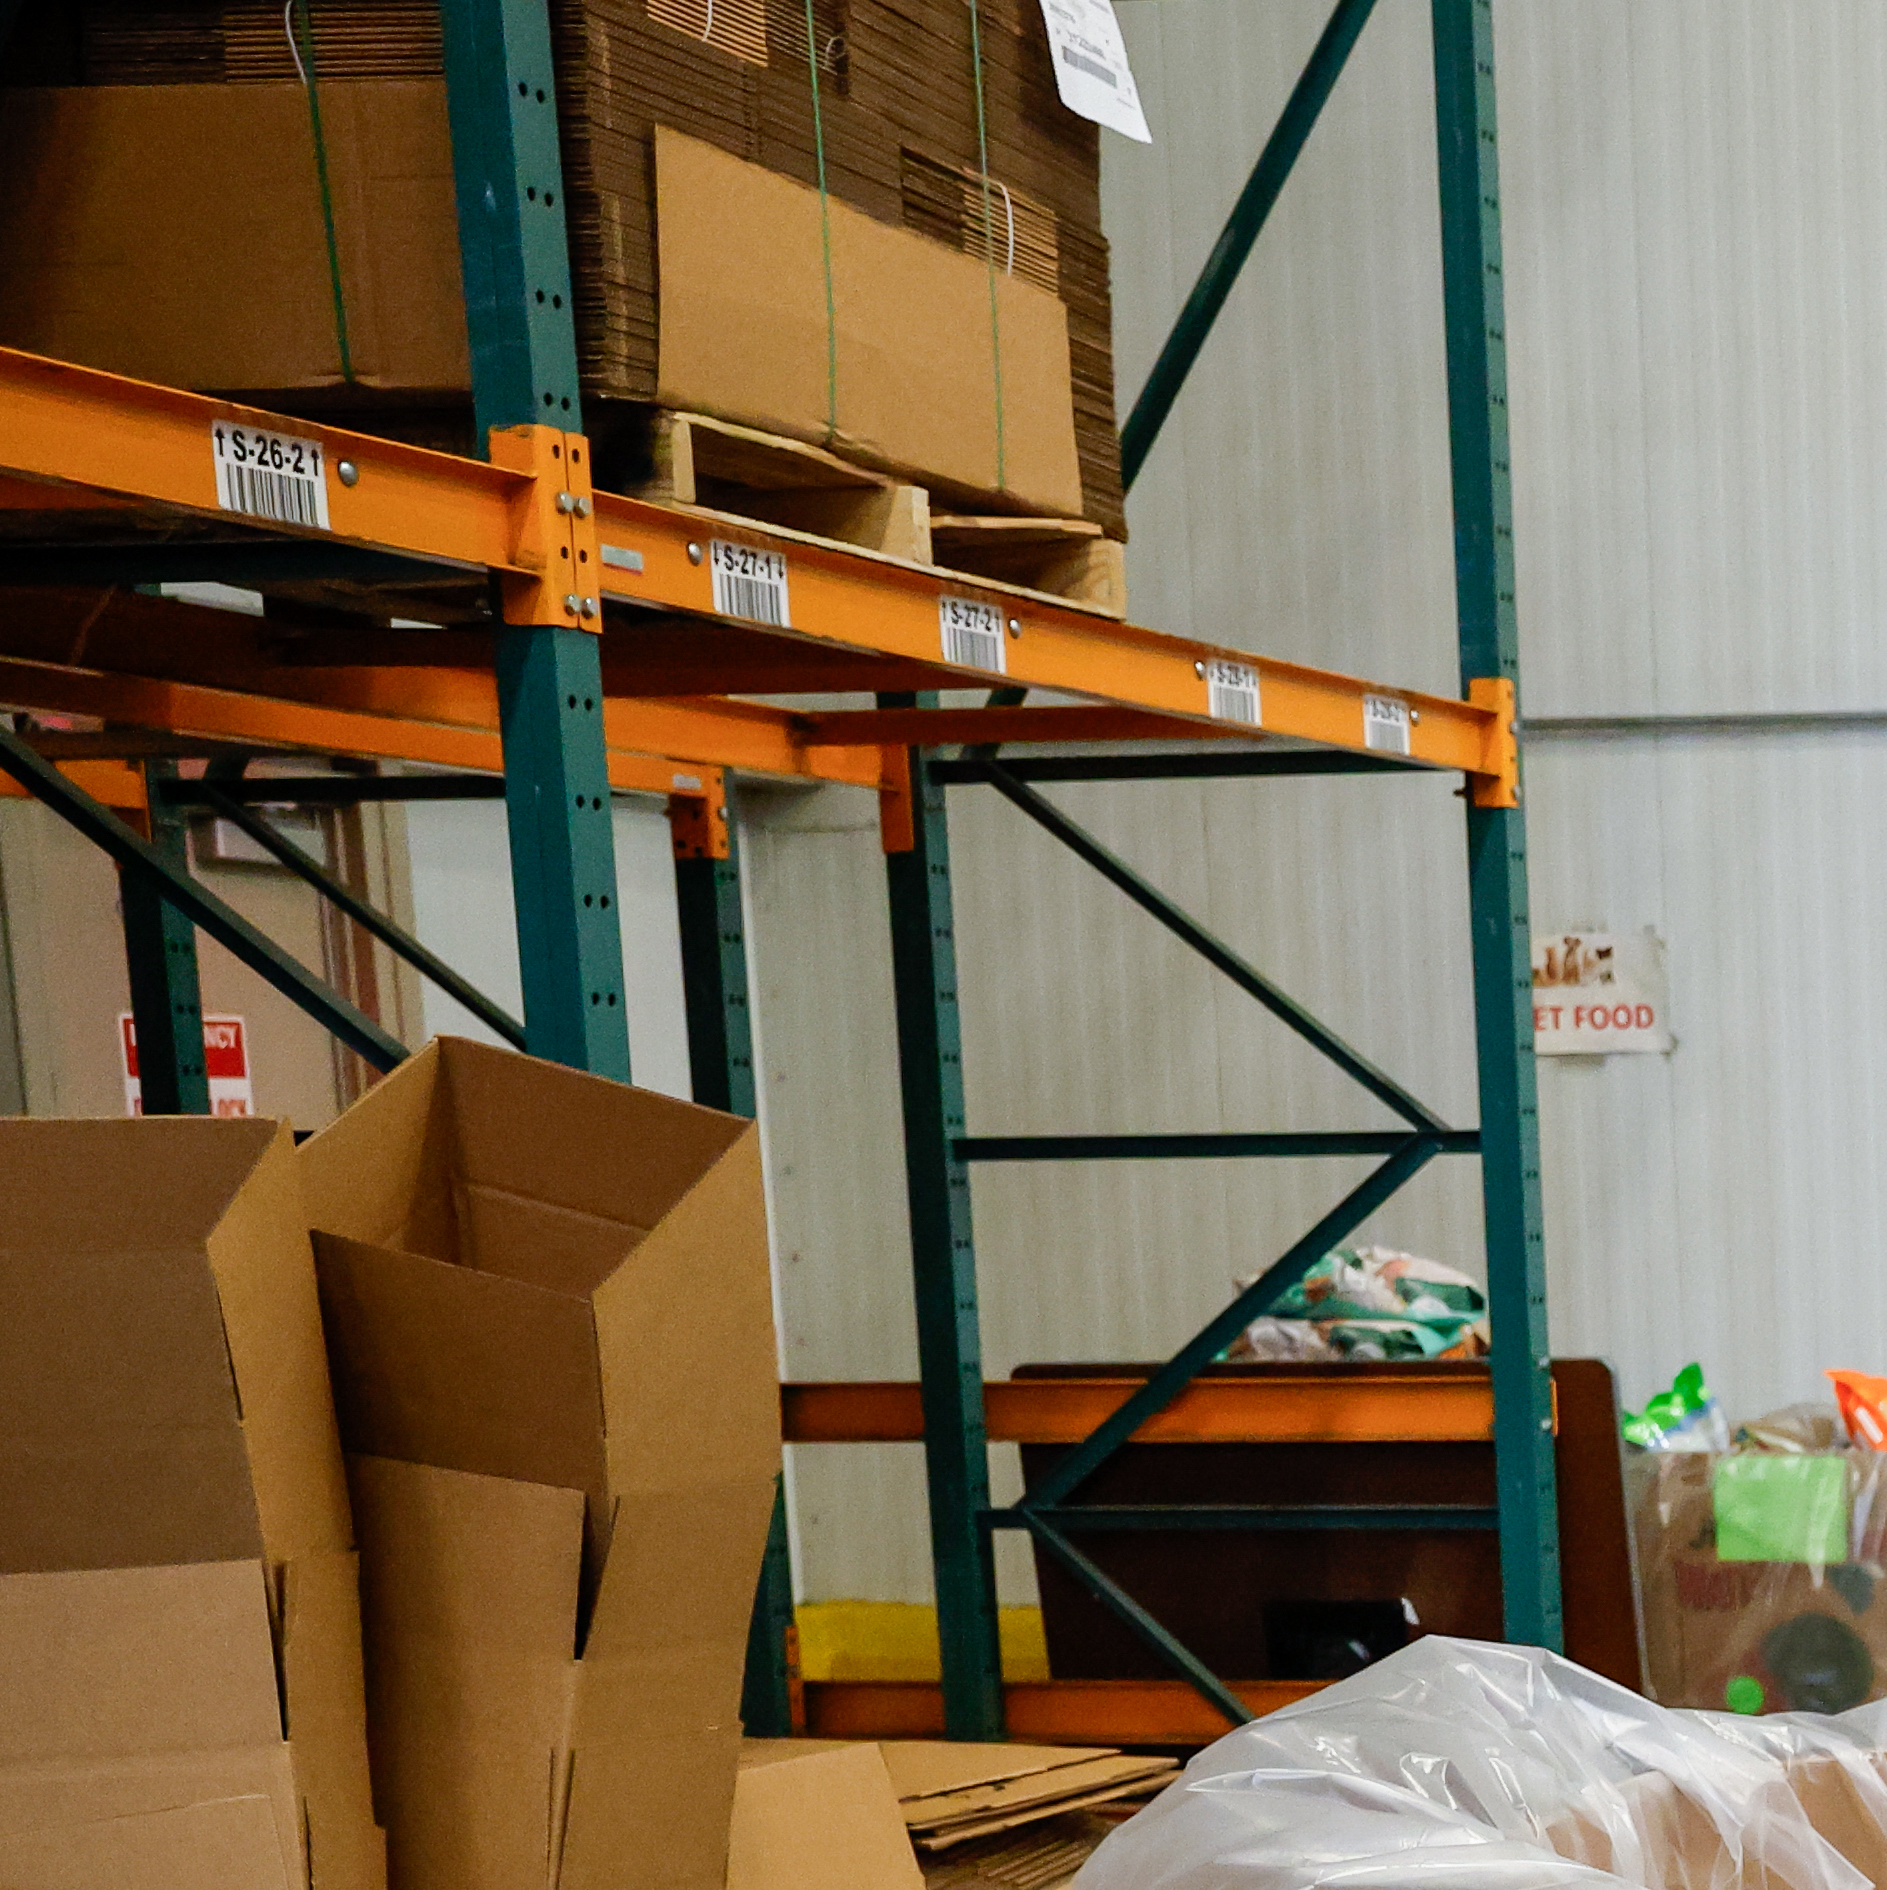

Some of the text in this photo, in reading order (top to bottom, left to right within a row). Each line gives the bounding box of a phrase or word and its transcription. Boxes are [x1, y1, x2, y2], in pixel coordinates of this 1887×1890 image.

[232, 429, 306, 474] S-26-2
[723, 544, 772, 580] S-27-1
[950, 601, 991, 632] S-27-2
[1533, 1003, 1654, 1031] ET FOOD
